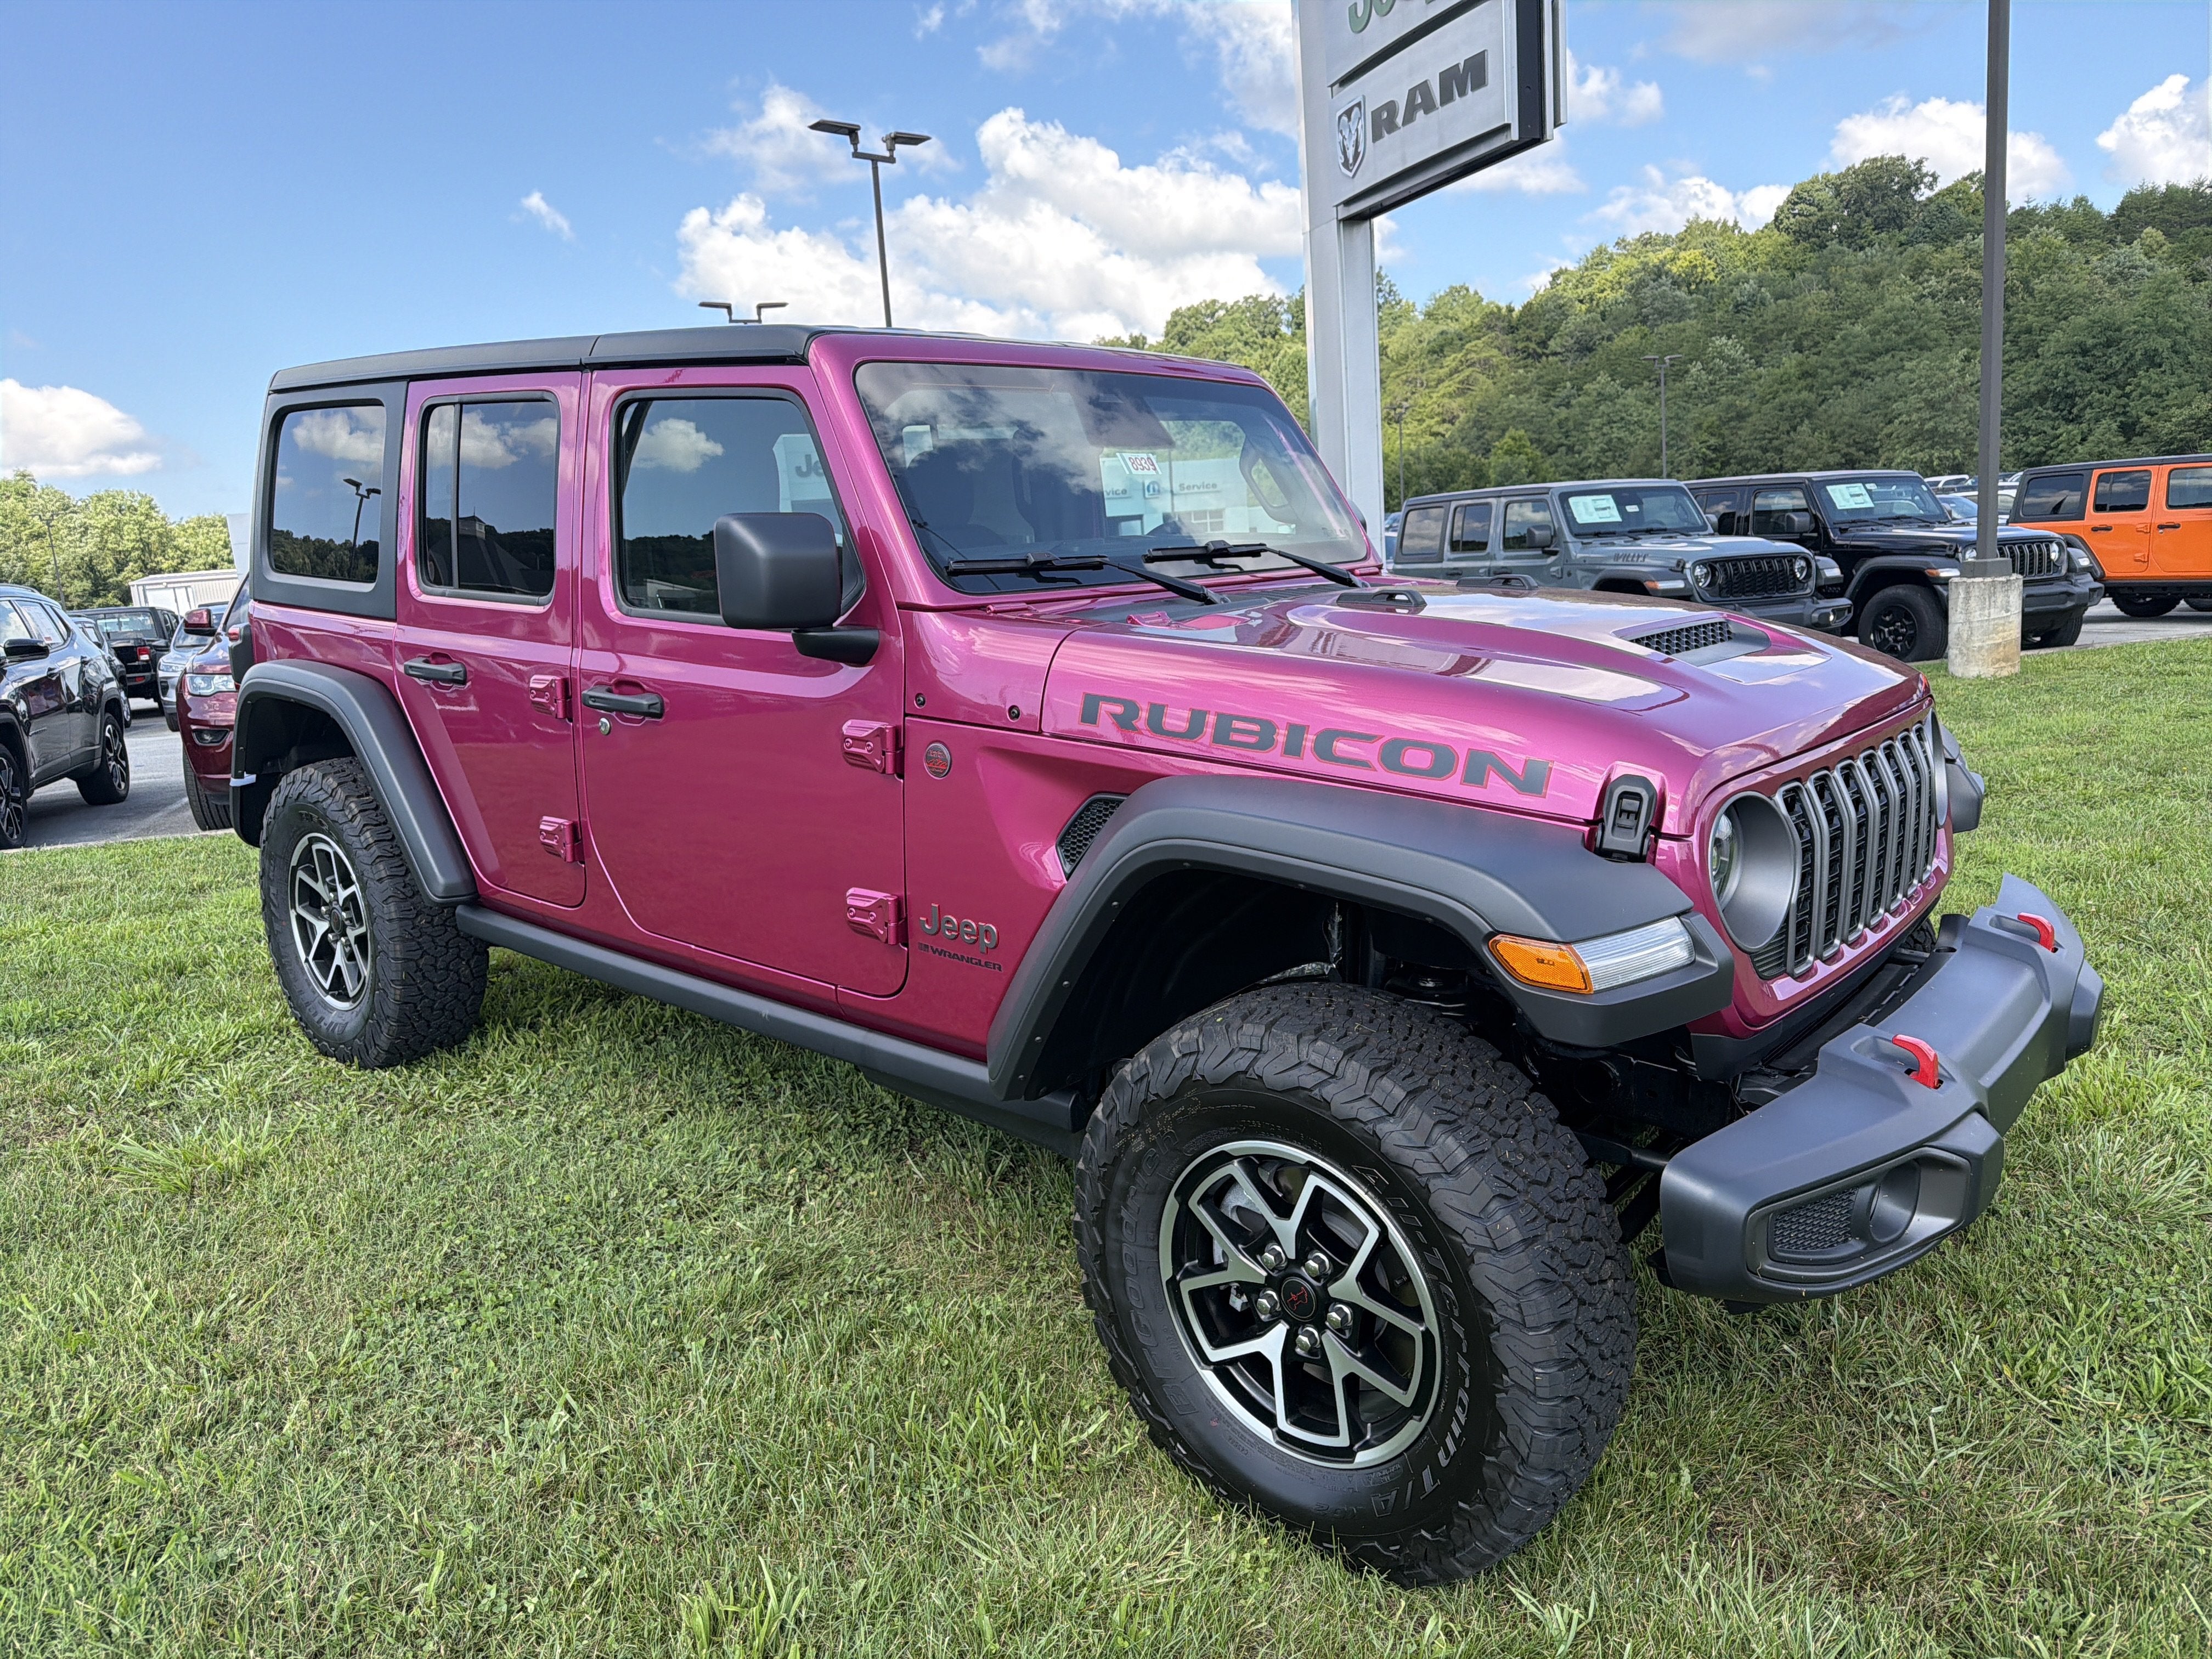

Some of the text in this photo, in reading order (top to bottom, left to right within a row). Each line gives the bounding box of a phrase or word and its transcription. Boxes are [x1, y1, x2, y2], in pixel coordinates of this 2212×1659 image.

[1372, 49, 1488, 143] RAM
[795, 454, 824, 478] Je
[1128, 456, 1156, 471] 8939
[1179, 482, 1217, 492] Service
[1079, 692, 1555, 799] RUBICON
[919, 903, 999, 955] Jeep
[930, 945, 1002, 972] WRANGLER
